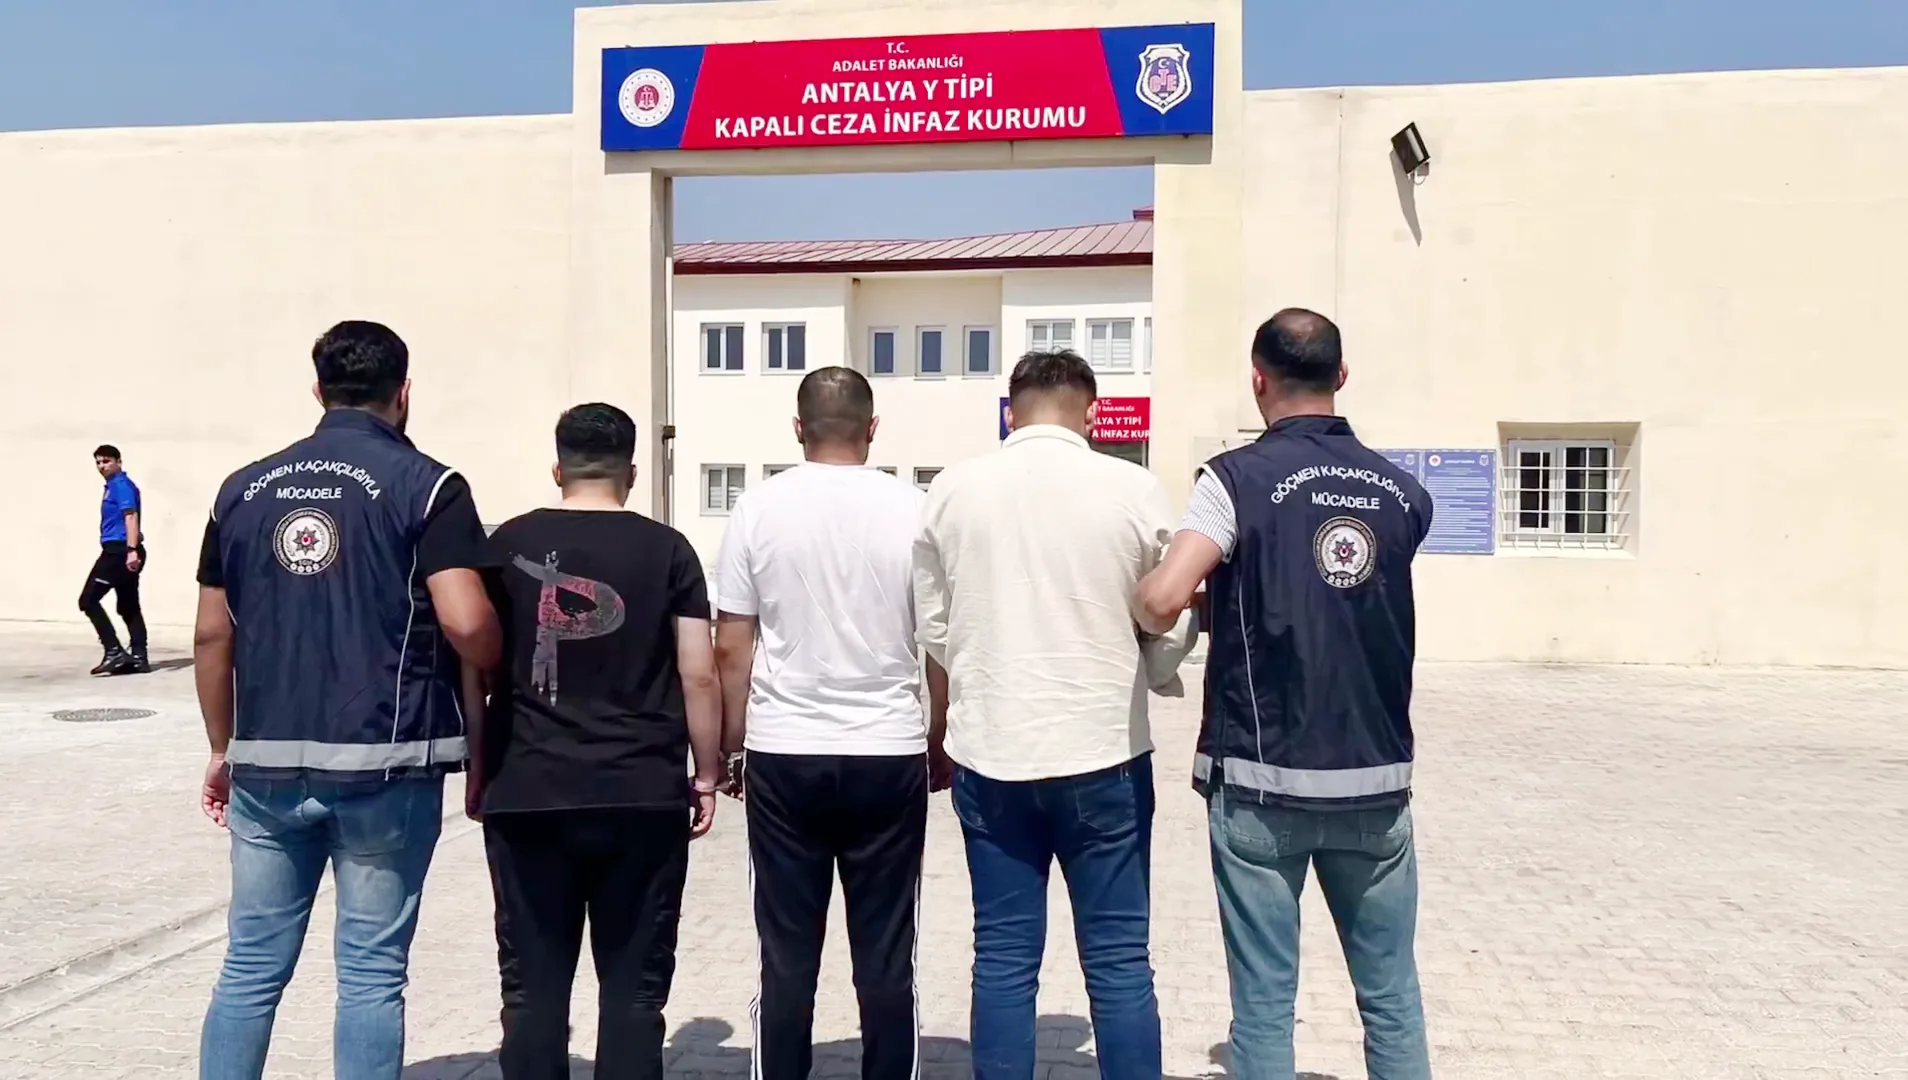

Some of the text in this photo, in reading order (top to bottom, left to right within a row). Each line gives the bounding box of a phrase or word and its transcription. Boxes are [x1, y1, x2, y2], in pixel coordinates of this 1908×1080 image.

[886, 42, 909, 54] T.C.
[832, 54, 964, 72] ADALET BAKANLIĞI
[801, 72, 993, 104] ANTALYA Y TİPİ
[714, 106, 1086, 139] KAPALI CEZA İNFAZ KURUMU
[1115, 416, 1122, 425] Y
[1101, 428, 1130, 439] İNFAZ
[1131, 429, 1150, 438] KUR
[243, 459, 381, 501] GÖÇMEN KAÇAKÇILIĞIYLA
[1270, 465, 1320, 504] GÖÇMEN
[276, 486, 342, 500] MÜCADELE
[1311, 491, 1380, 510] MÜCADELE
